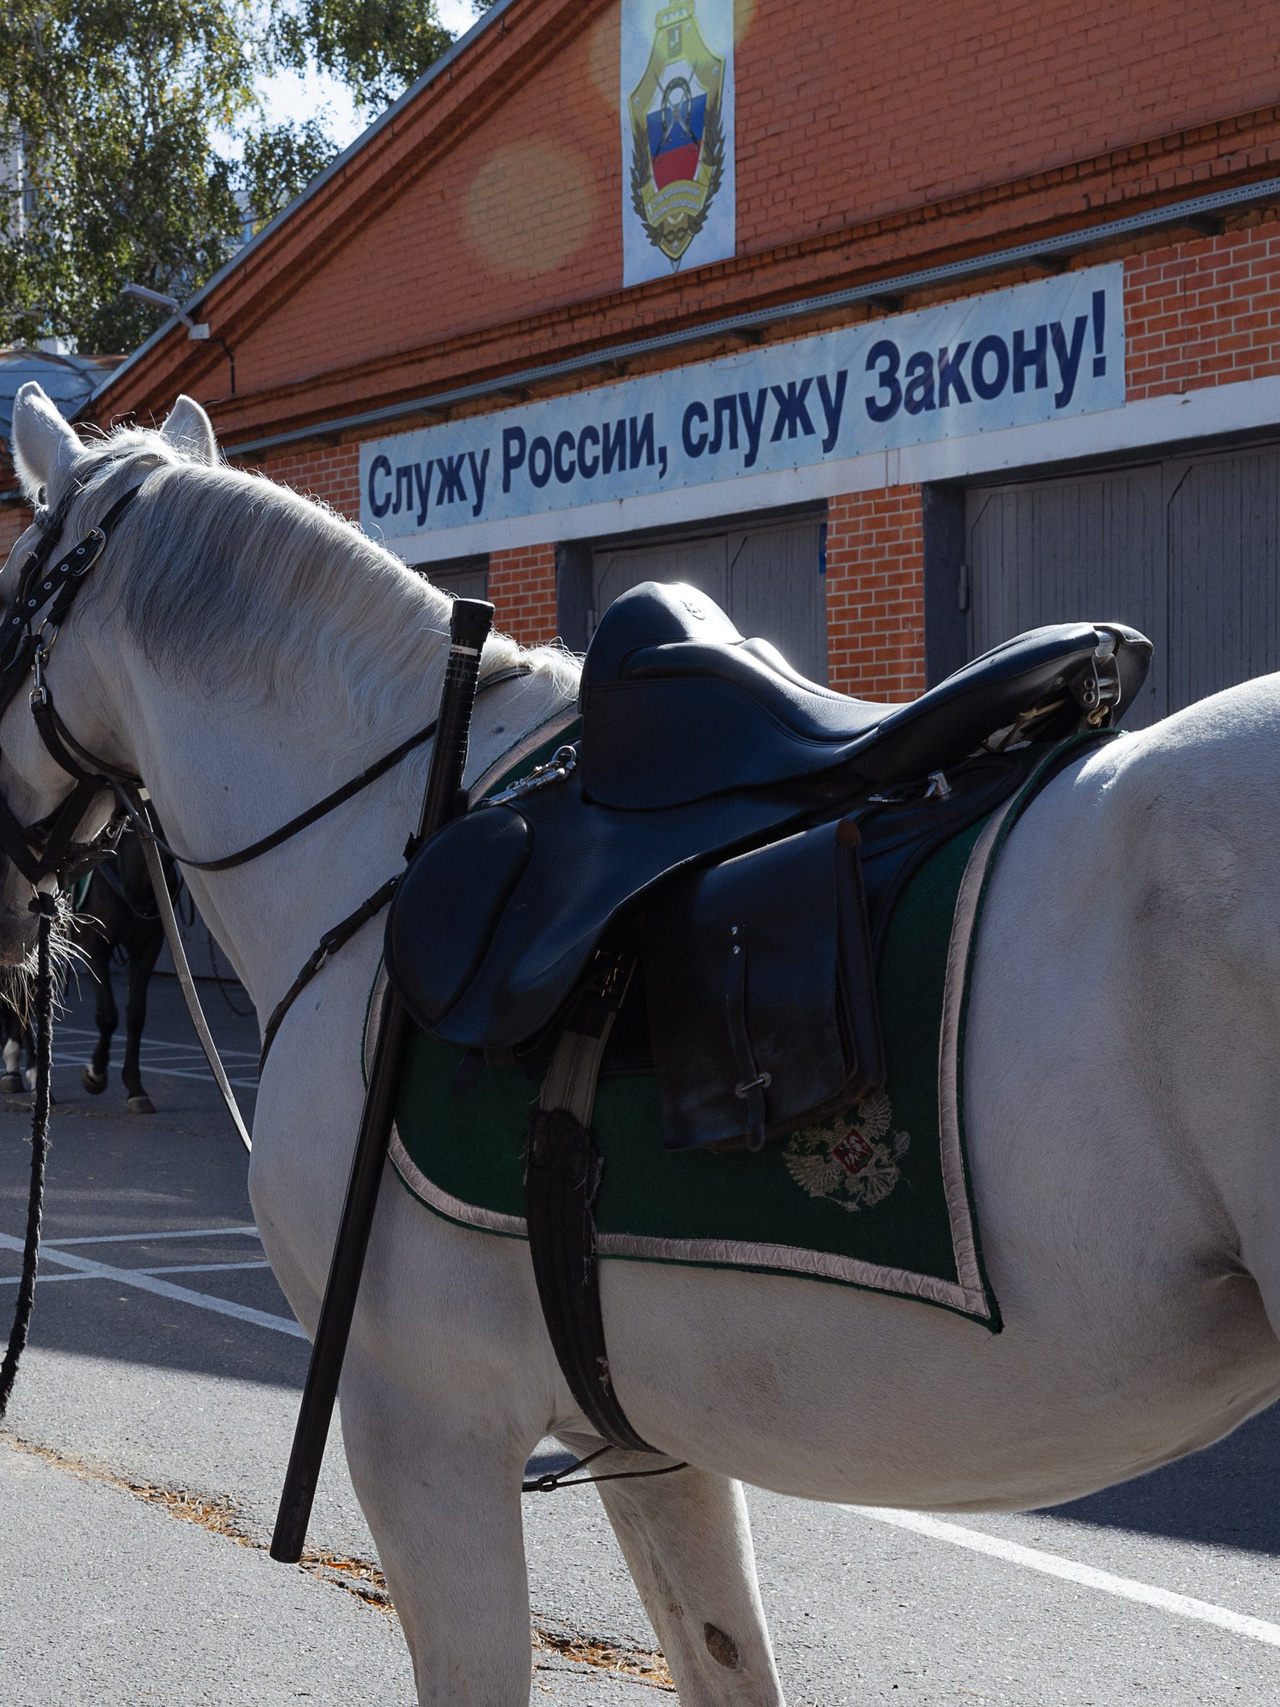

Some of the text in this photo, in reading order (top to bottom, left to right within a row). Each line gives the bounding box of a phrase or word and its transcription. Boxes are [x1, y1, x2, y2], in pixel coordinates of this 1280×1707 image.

[369, 289, 1107, 527] Служу России, служу Закону!
